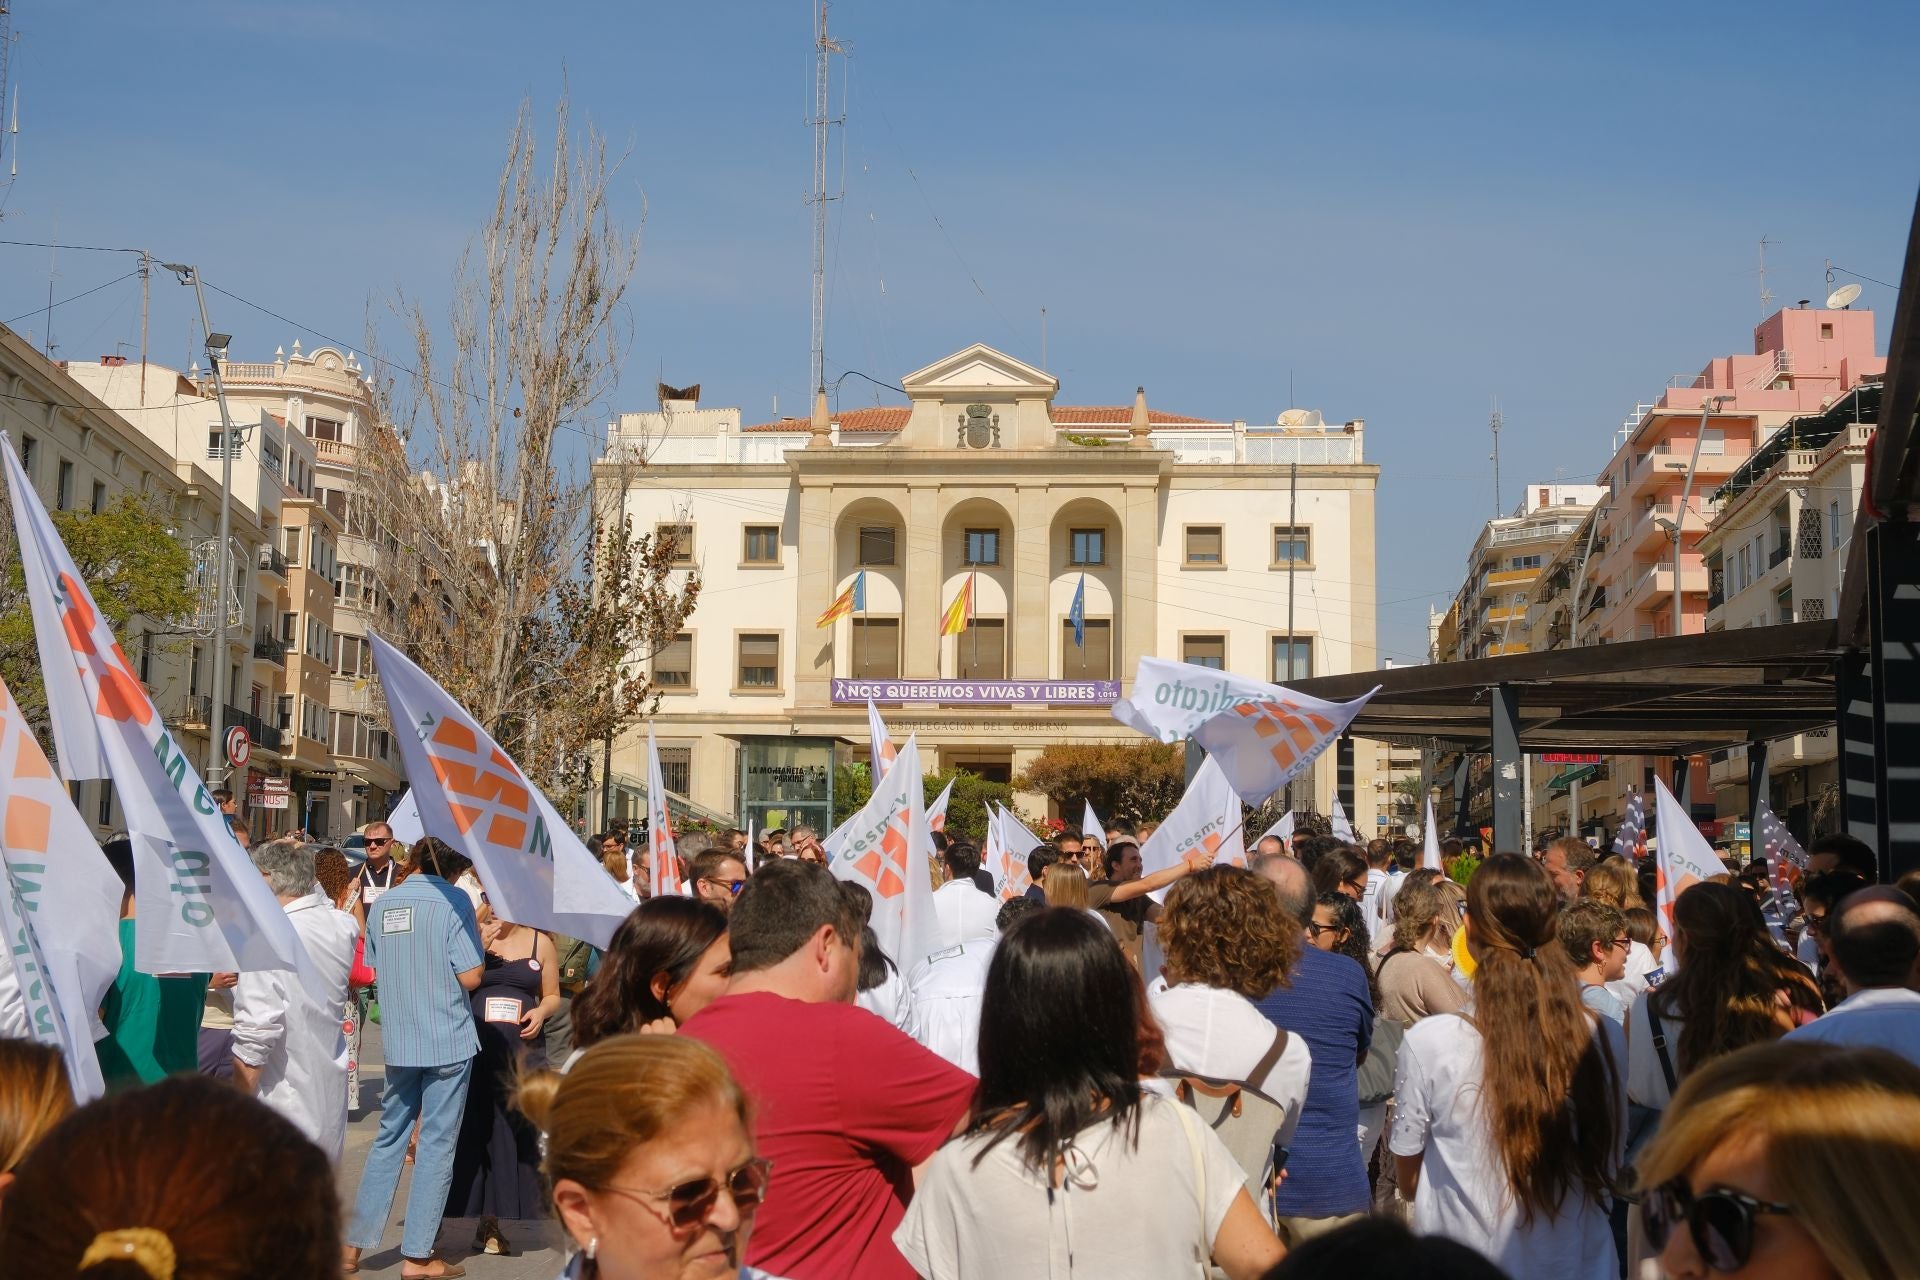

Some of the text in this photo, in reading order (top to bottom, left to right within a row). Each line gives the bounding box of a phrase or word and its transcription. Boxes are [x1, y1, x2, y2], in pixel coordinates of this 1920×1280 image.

[848, 685, 1095, 699] NOS QUEREMOS VIVAS Y LIBRES
[983, 721, 1004, 731] DEL
[1012, 721, 1068, 731] GOBIERNO
[1543, 753, 1598, 762] COMPLETO
[760, 765, 805, 775] MONTAÑETA
[774, 774, 805, 782] PARKING
